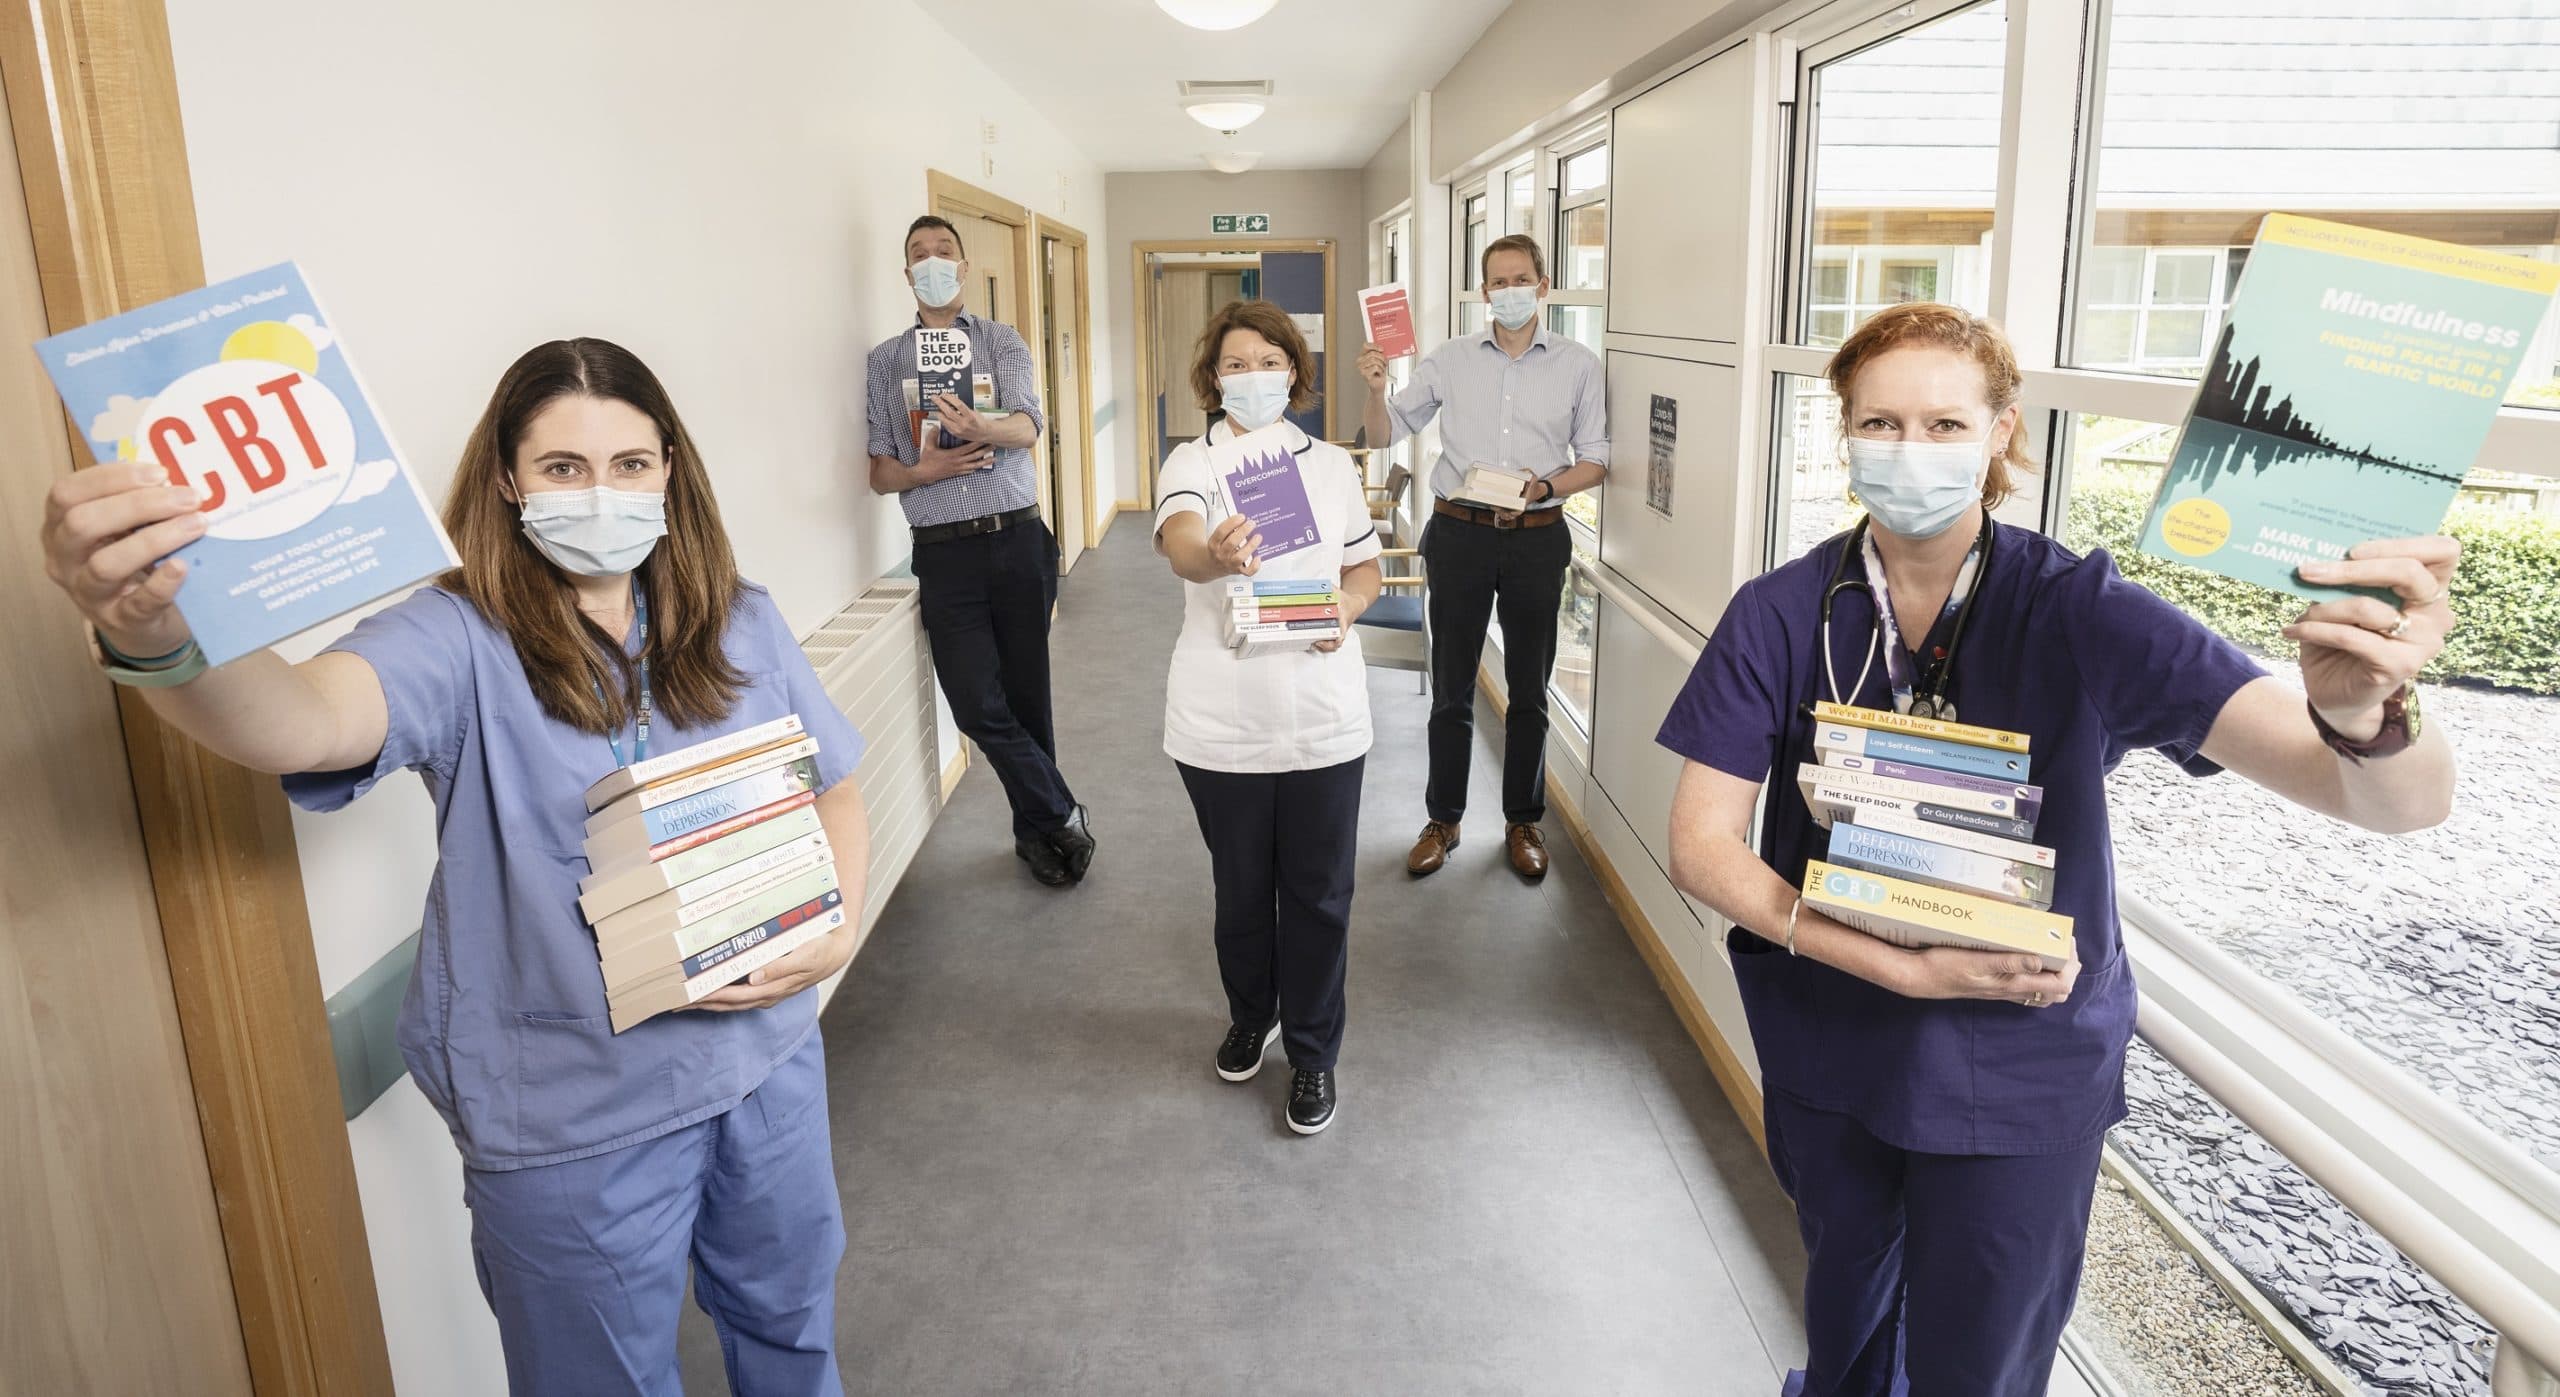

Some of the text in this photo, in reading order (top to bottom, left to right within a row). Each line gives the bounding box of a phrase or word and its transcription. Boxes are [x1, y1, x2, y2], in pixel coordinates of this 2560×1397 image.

[2286, 225, 2341, 241] INCLUDES
[2342, 234, 2369, 248] FREE
[2391, 243, 2407, 255] OF
[2409, 247, 2455, 265] GUIDED
[2457, 255, 2539, 281] MEDITATIONS
[2319, 287, 2521, 349] Mindfulness
[920, 332, 949, 342] THE
[921, 343, 966, 354] SLEEP
[921, 355, 963, 366] BOOK
[2319, 329, 2504, 383] FINDING PEACE IN A
[2343, 354, 2498, 400] FRANTIC WORLD
[148, 372, 328, 513] CBT
[1235, 465, 1289, 488] OVERCOMING
[250, 525, 355, 572] YOUR TOOLKIT TO
[2258, 525, 2313, 551] MARK
[229, 571, 277, 597] MODIFY
[321, 526, 387, 558] OVERCOME
[258, 545, 375, 600] OBSTRUCTIONS AND
[265, 556, 381, 611] IMPROVE YOUR LIFE
[1828, 706, 1858, 719] We're
[1860, 710, 1876, 722] all
[1878, 714, 1909, 727] MAD
[1910, 719, 1937, 732] here
[1869, 737, 1887, 747] Low
[1887, 740, 1935, 756] Self-Esteem
[1804, 767, 1844, 782] Grief
[1885, 764, 1908, 776] Panic
[658, 790, 734, 823] DEFEATING
[663, 801, 738, 837] DEPRESSION
[1823, 789, 2000, 829] THE SLEEP BOOK Dr Guy Meadows
[1847, 844, 1934, 873] DEPRESSION
[1850, 828, 1936, 859] DEFEATING
[1809, 869, 1823, 892] THE
[1829, 875, 1881, 899] CBT
[1890, 893, 1974, 921] HANDBOOK
